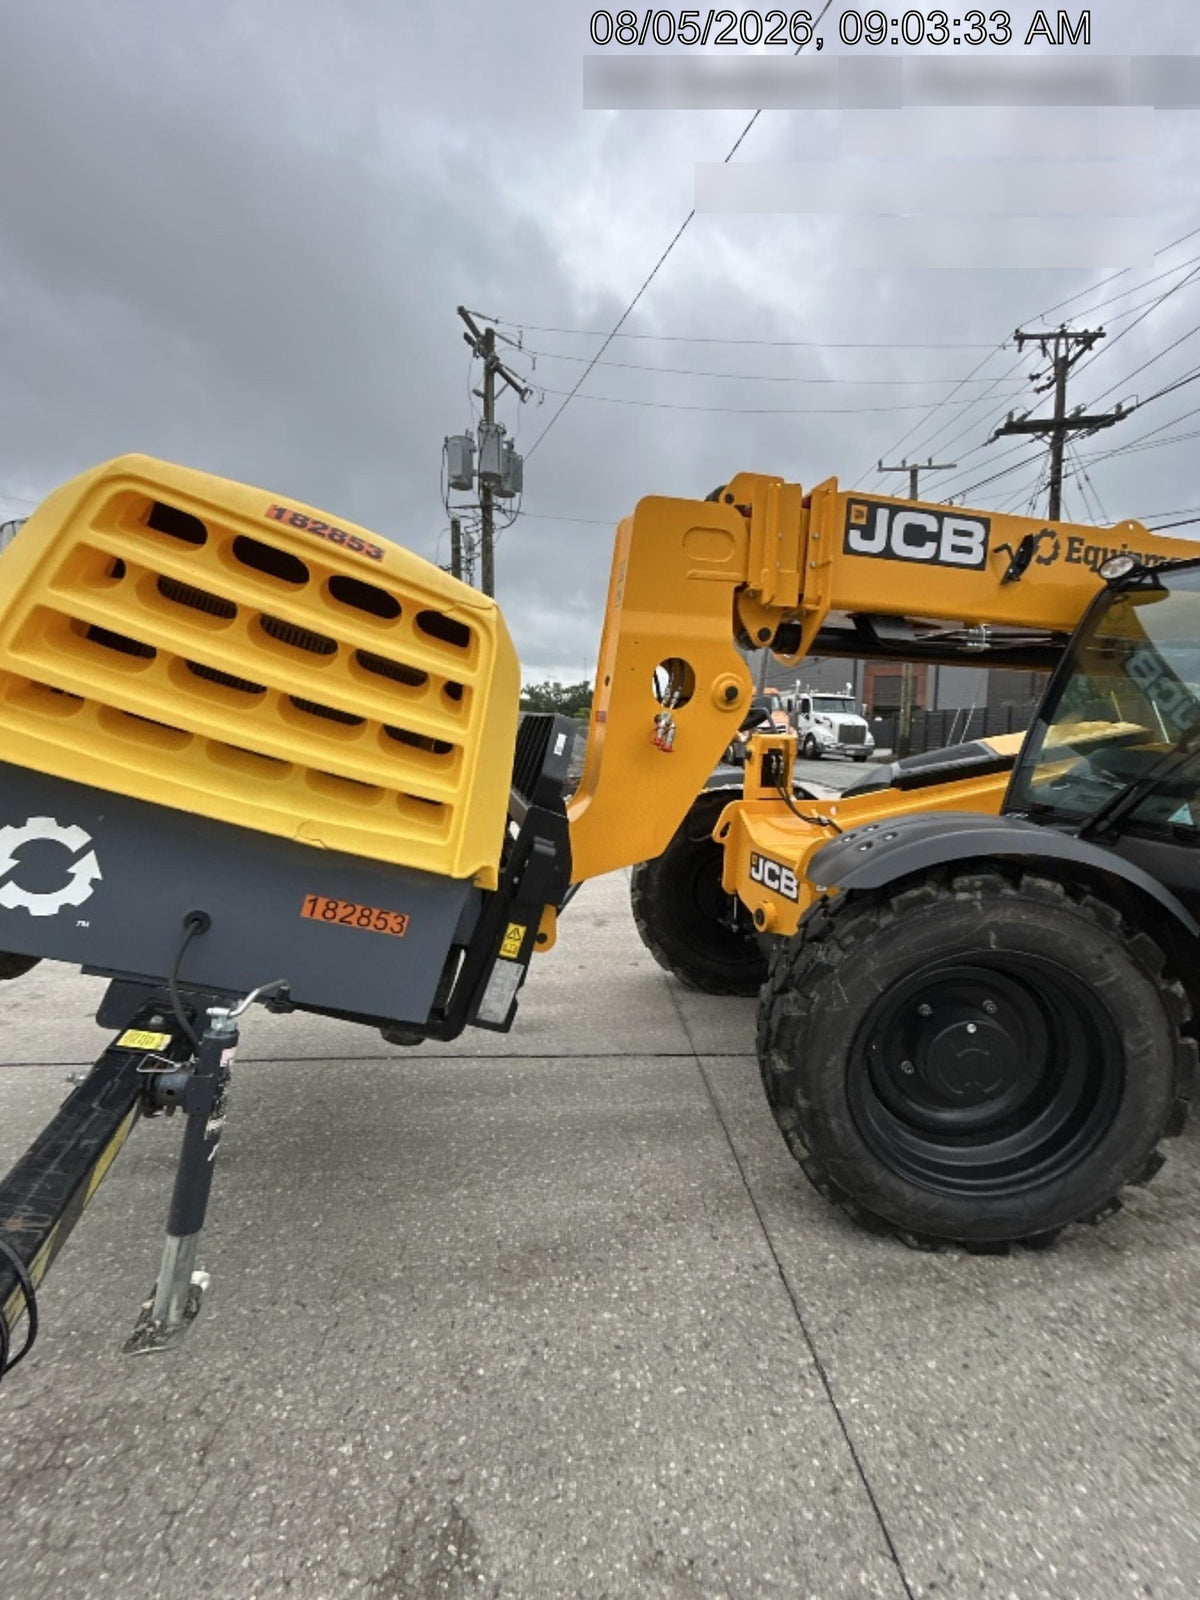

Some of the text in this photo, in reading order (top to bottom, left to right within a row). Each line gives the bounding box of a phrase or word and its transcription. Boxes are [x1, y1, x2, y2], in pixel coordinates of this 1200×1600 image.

[274, 506, 384, 560] 182853
[848, 508, 986, 565] JCB
[751, 856, 799, 899] JCB
[308, 897, 406, 934] 182853
